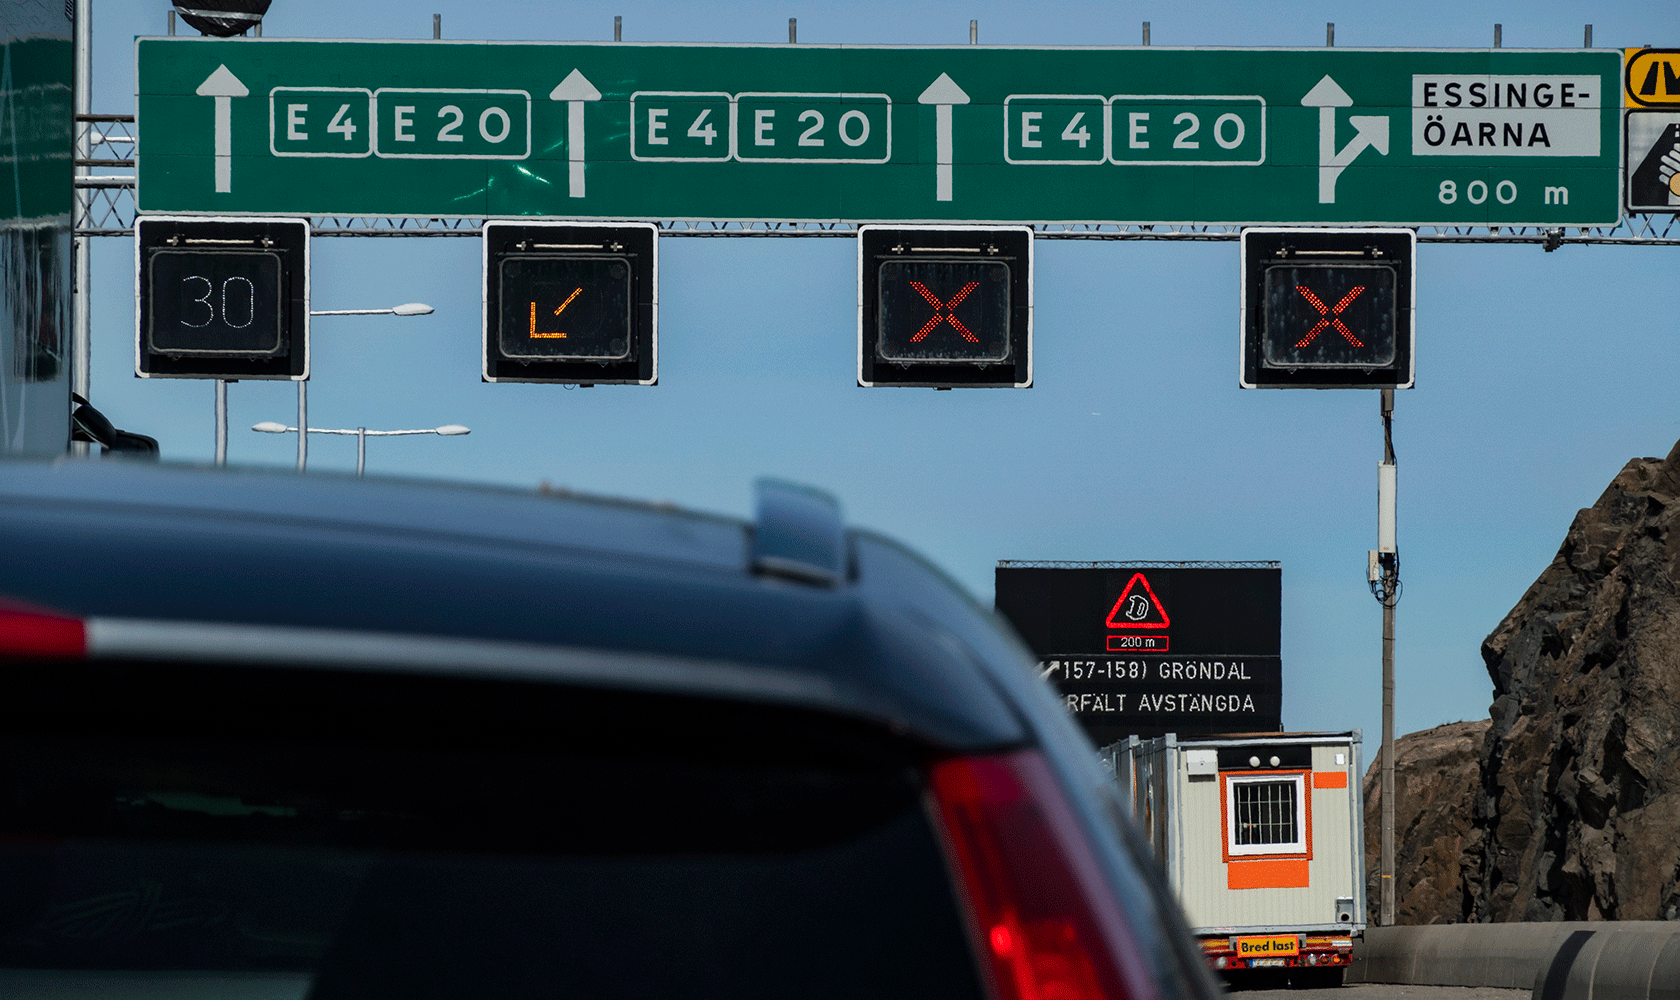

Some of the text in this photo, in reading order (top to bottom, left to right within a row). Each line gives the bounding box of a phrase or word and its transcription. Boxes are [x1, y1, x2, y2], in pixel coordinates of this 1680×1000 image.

[1423, 82, 1590, 108] ESSINGE-
[288, 103, 357, 141] E 4
[394, 104, 511, 144] E 20
[648, 108, 718, 146] E 4
[754, 109, 870, 147] E 20
[1021, 111, 1091, 148] E 4
[1128, 112, 1246, 150] E 20
[1423, 114, 1551, 147] ÖARNA
[1438, 179, 1569, 205] 800 m
[180, 275, 255, 329] 30
[1120, 636, 1155, 648] 200 m
[1159, 660, 1252, 680] GRÖNDAL
[1062, 693, 1256, 713] RFÄLT AVSTÄNGDA
[1241, 940, 1295, 952] Bred last
